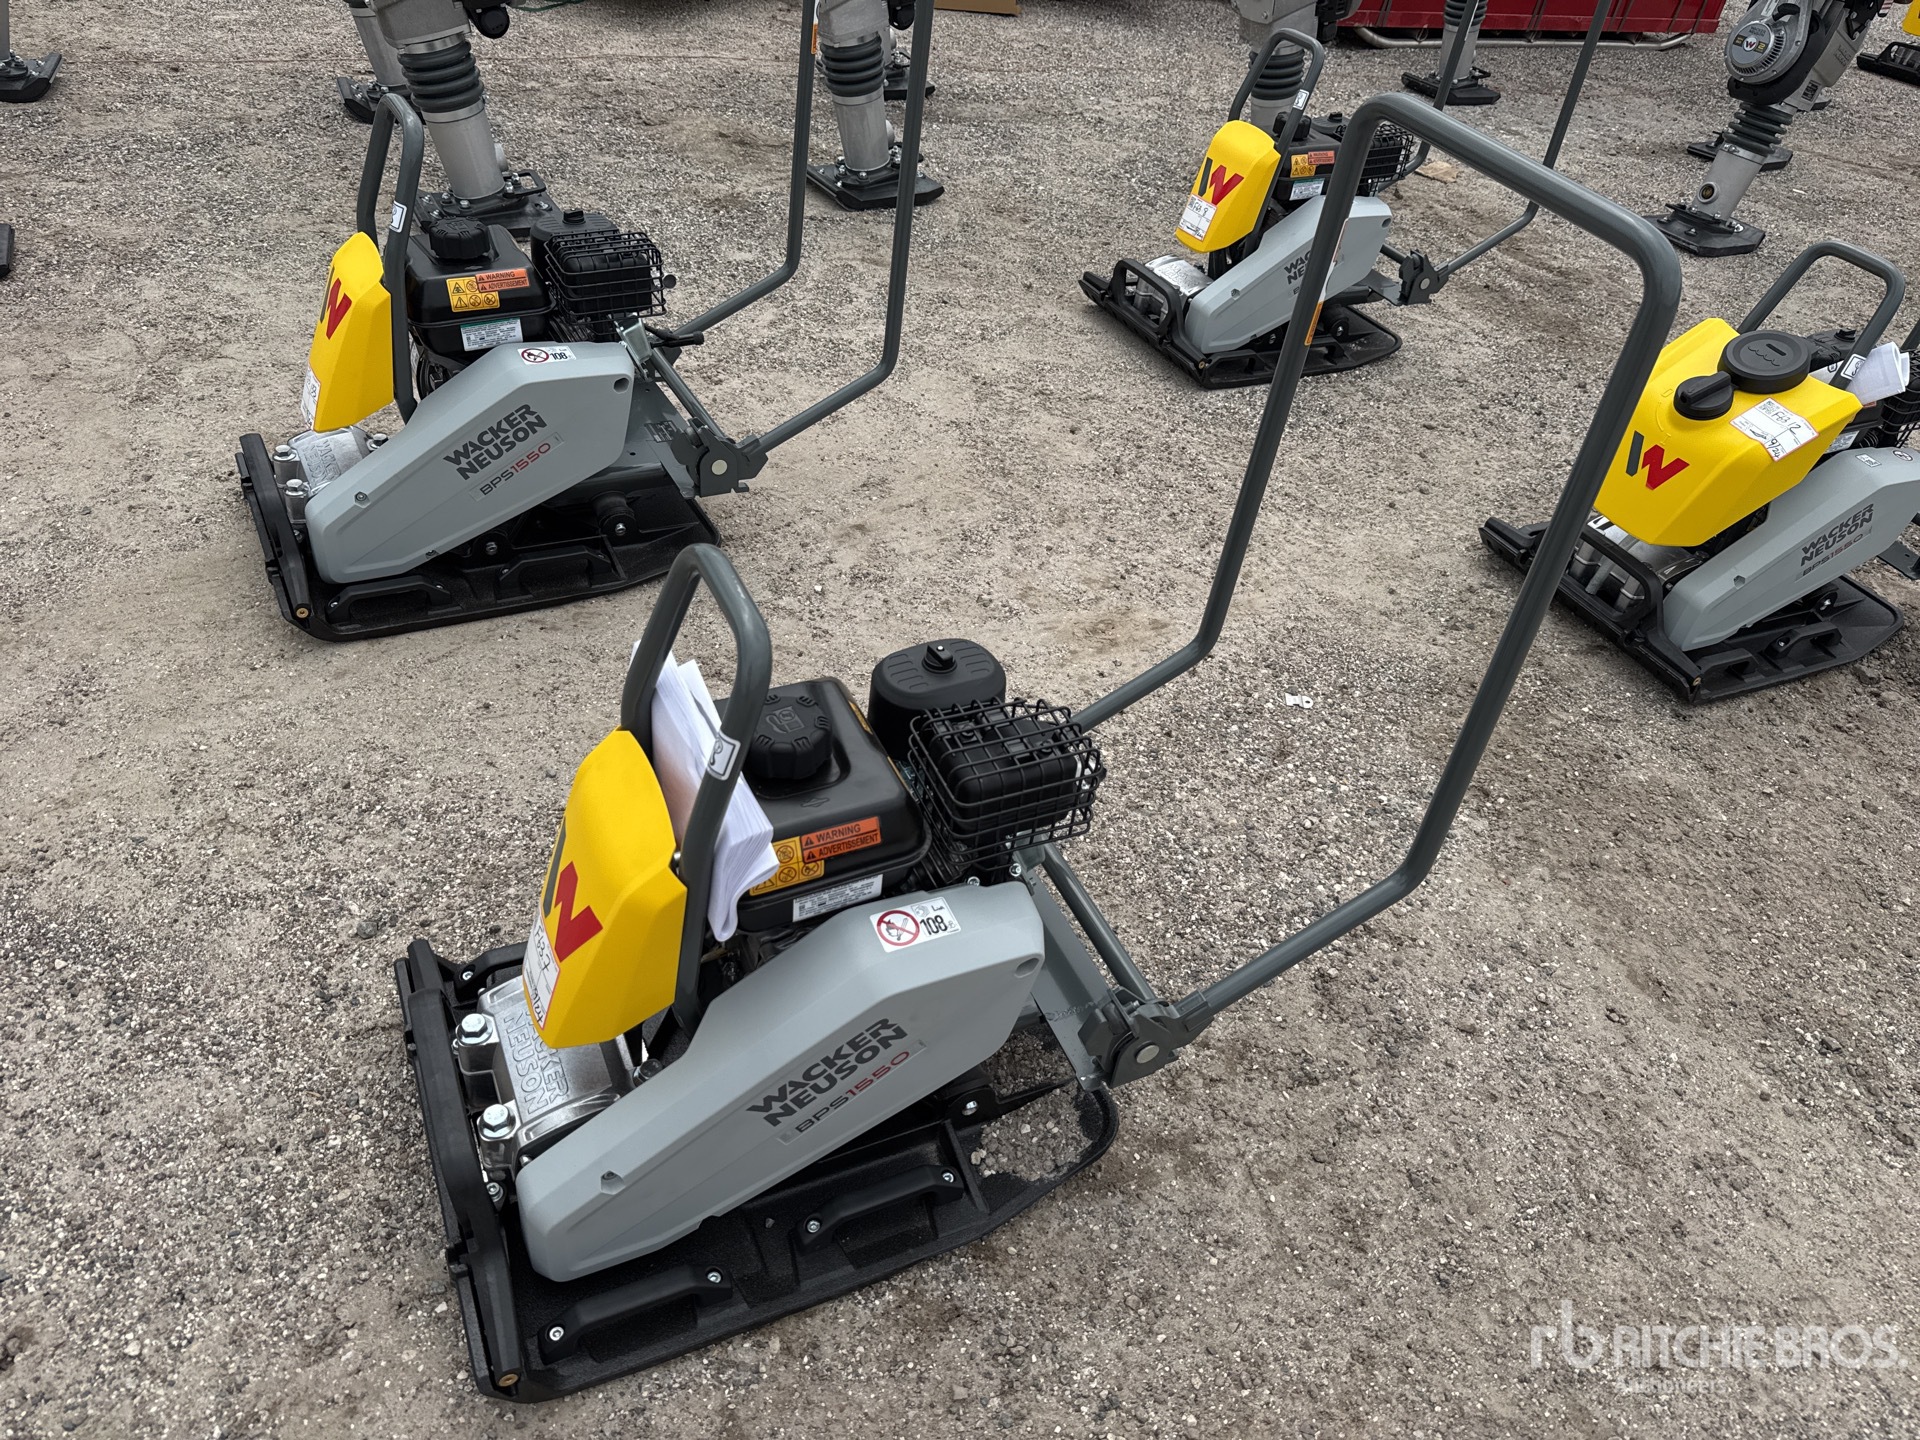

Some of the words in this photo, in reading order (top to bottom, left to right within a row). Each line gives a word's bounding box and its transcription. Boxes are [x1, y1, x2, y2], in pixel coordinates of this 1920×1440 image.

[485, 271, 515, 280] WARNING
[488, 279, 527, 290] ADVERTISSEMENT
[550, 352, 568, 360] 108
[443, 404, 538, 466] WACKER
[1771, 411, 1791, 423] F63
[456, 414, 548, 481] NEUSON
[480, 442, 551, 496] BPS1550
[1800, 512, 1874, 567] NEUSON
[1802, 503, 1874, 555] WACKER
[1803, 534, 1864, 576] BPS1550
[816, 824, 861, 842] WARNING
[818, 833, 879, 857] ADVERTISSEMENT
[920, 915, 948, 935] 108
[503, 1012, 550, 1115] NEUSON
[745, 1018, 898, 1113] WACKER
[763, 1025, 908, 1127] NEUSON
[795, 1051, 910, 1133] BPS1550
